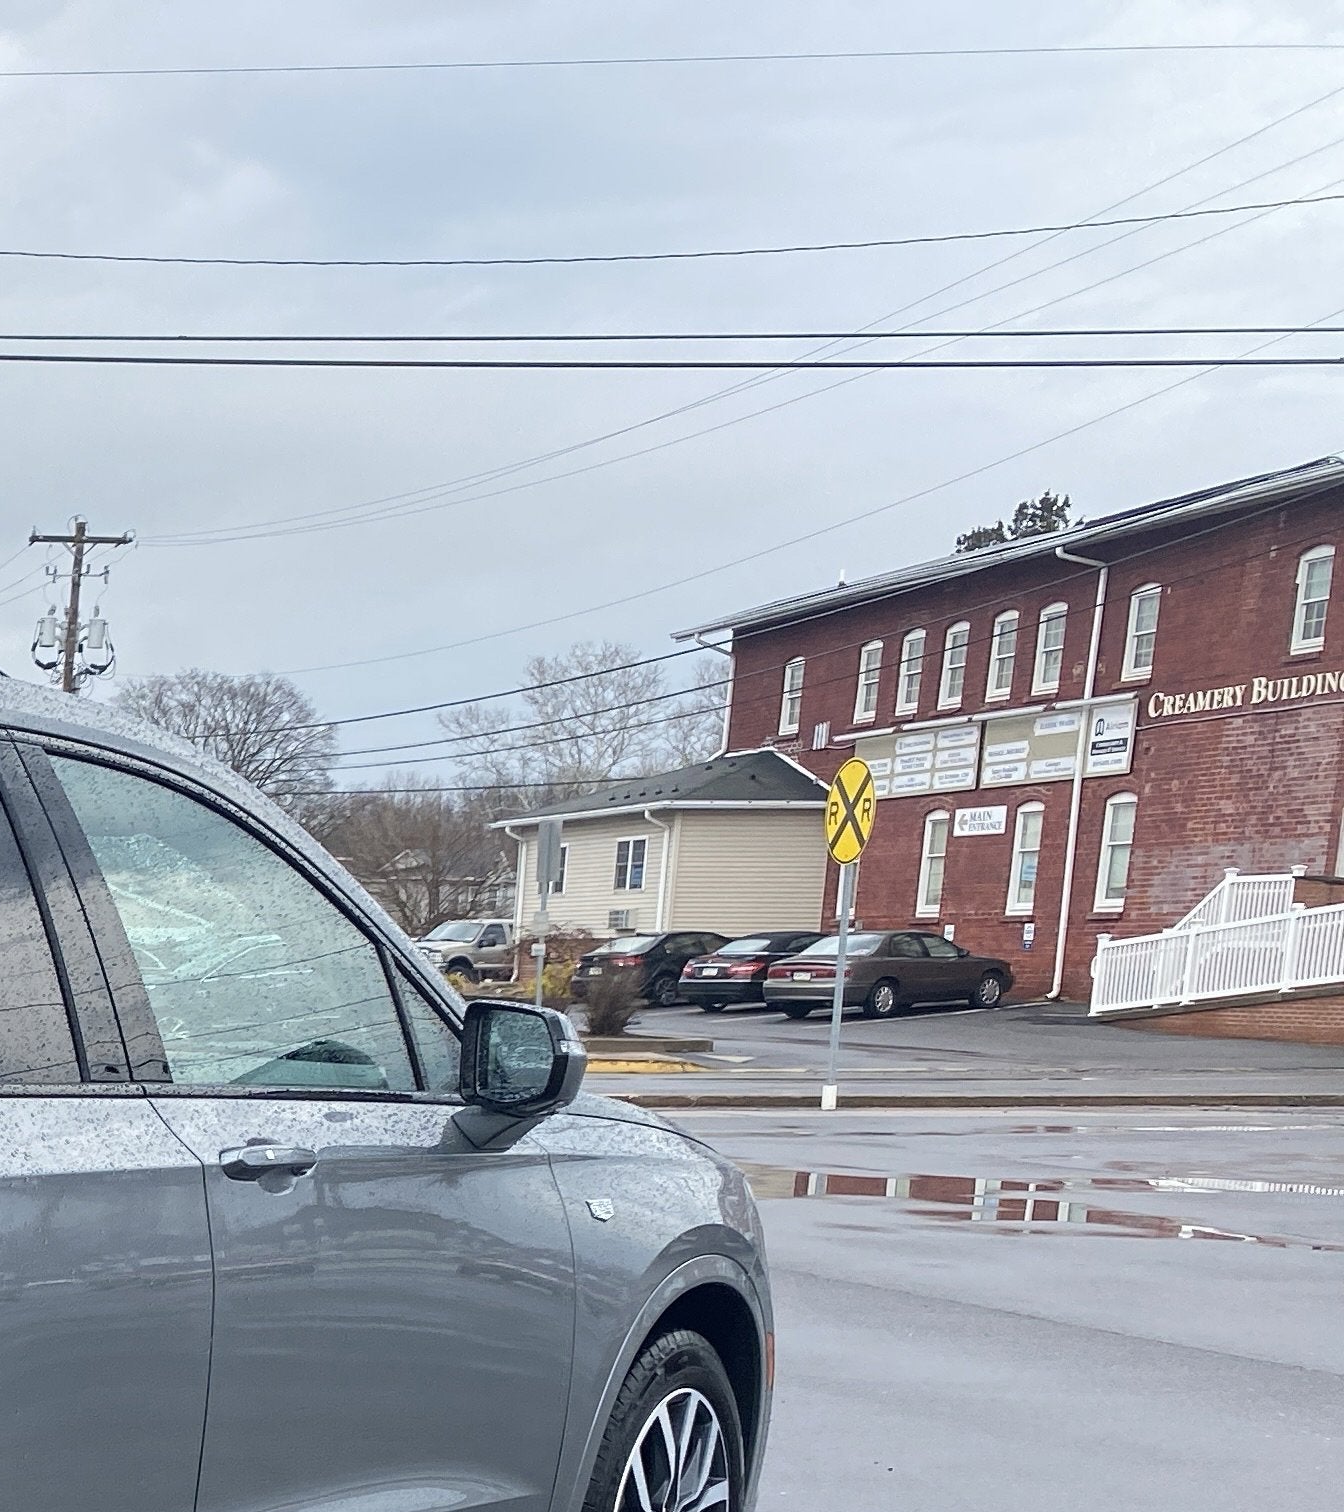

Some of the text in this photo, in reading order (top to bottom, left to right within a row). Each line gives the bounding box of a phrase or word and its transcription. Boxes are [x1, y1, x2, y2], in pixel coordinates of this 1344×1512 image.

[828, 798, 871, 826] R R
[969, 811, 993, 822] MAIN
[968, 821, 1003, 832] ENTRANCE
